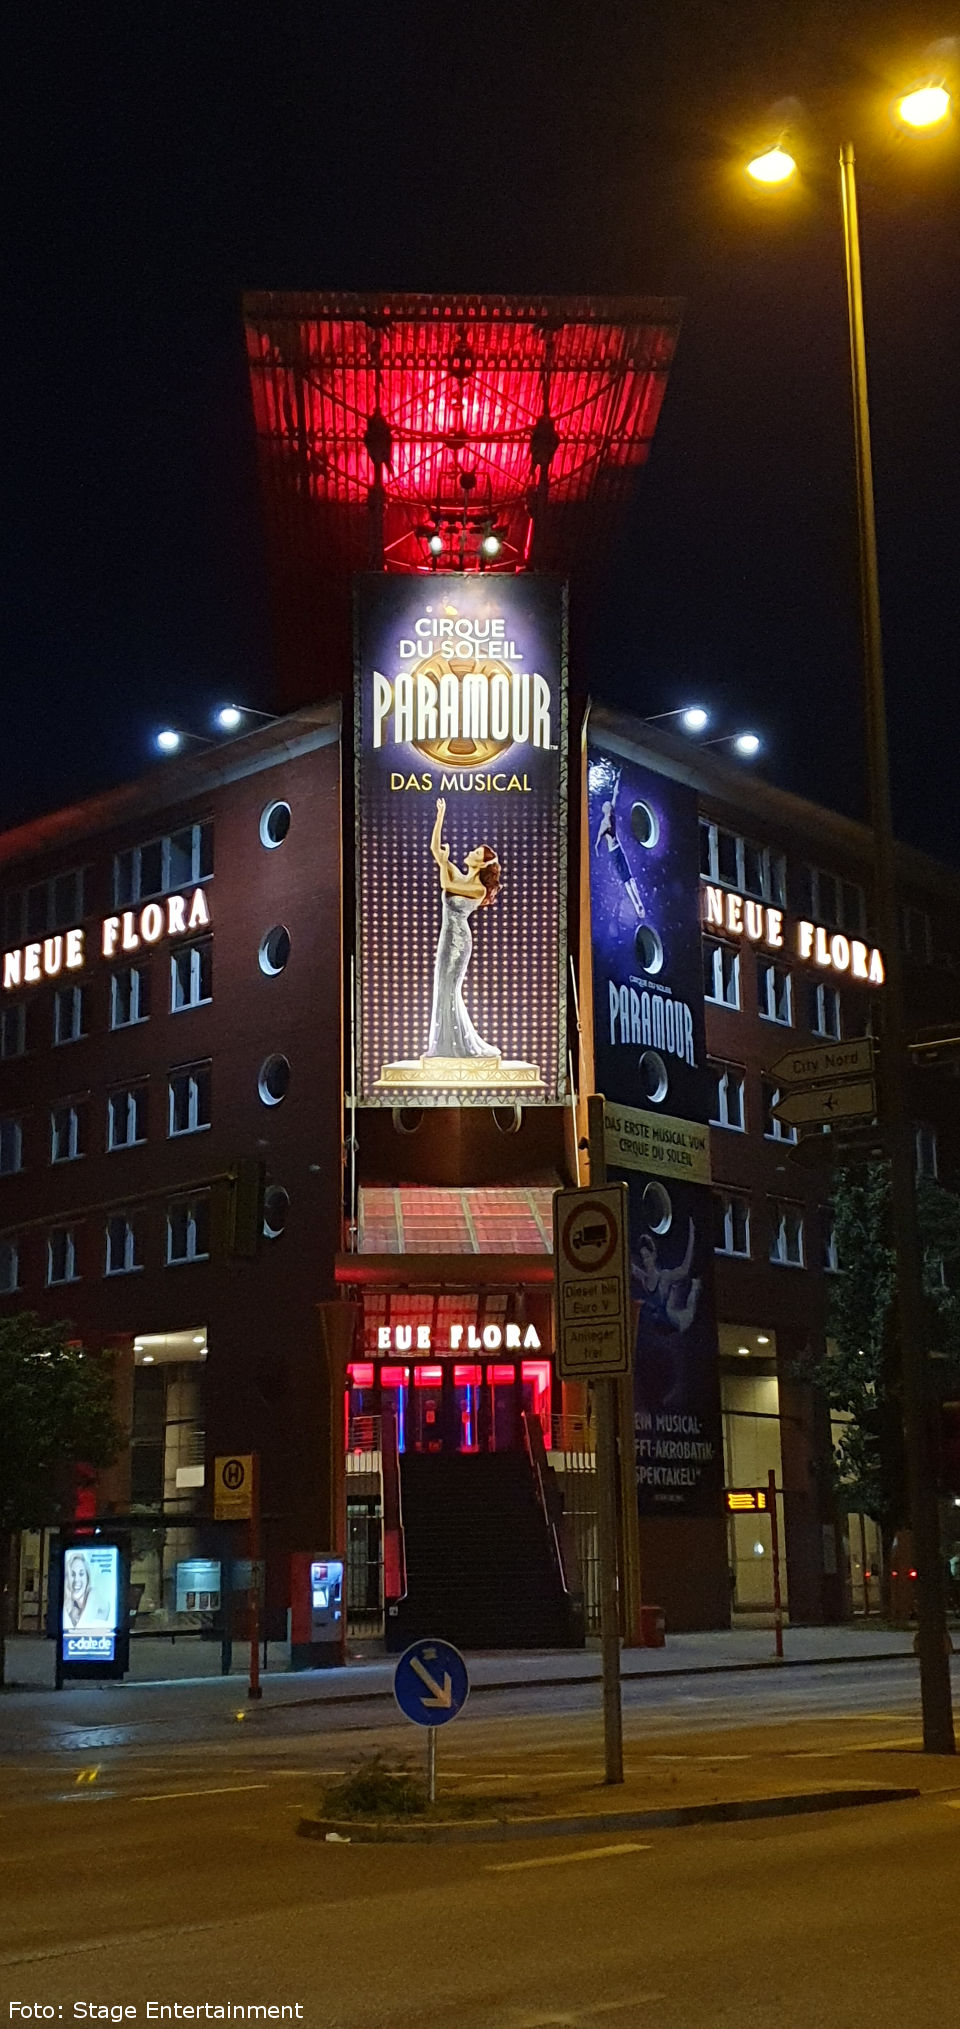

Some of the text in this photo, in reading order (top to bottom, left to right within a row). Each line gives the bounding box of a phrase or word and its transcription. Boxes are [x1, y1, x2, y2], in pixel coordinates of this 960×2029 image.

[415, 618, 506, 642] CIRQUE
[399, 640, 523, 659] DU SOLEIL
[373, 671, 551, 750] PARAMOUR
[390, 773, 532, 791] DAS MUSICAL
[3, 887, 210, 989] NEUE FLORA
[705, 885, 886, 985] NEUE FLORA
[609, 979, 695, 1067] PARAMOUR
[825, 1049, 858, 1069] Nord
[605, 1116, 705, 1151] DAS ERSTE MUSICAL VON
[620, 1138, 693, 1166] CIRQUE DU SOLEIL
[574, 1300, 609, 1313] Euro V
[450, 1323, 541, 1348] FLORA
[655, 1413, 703, 1434] MUSICAL-
